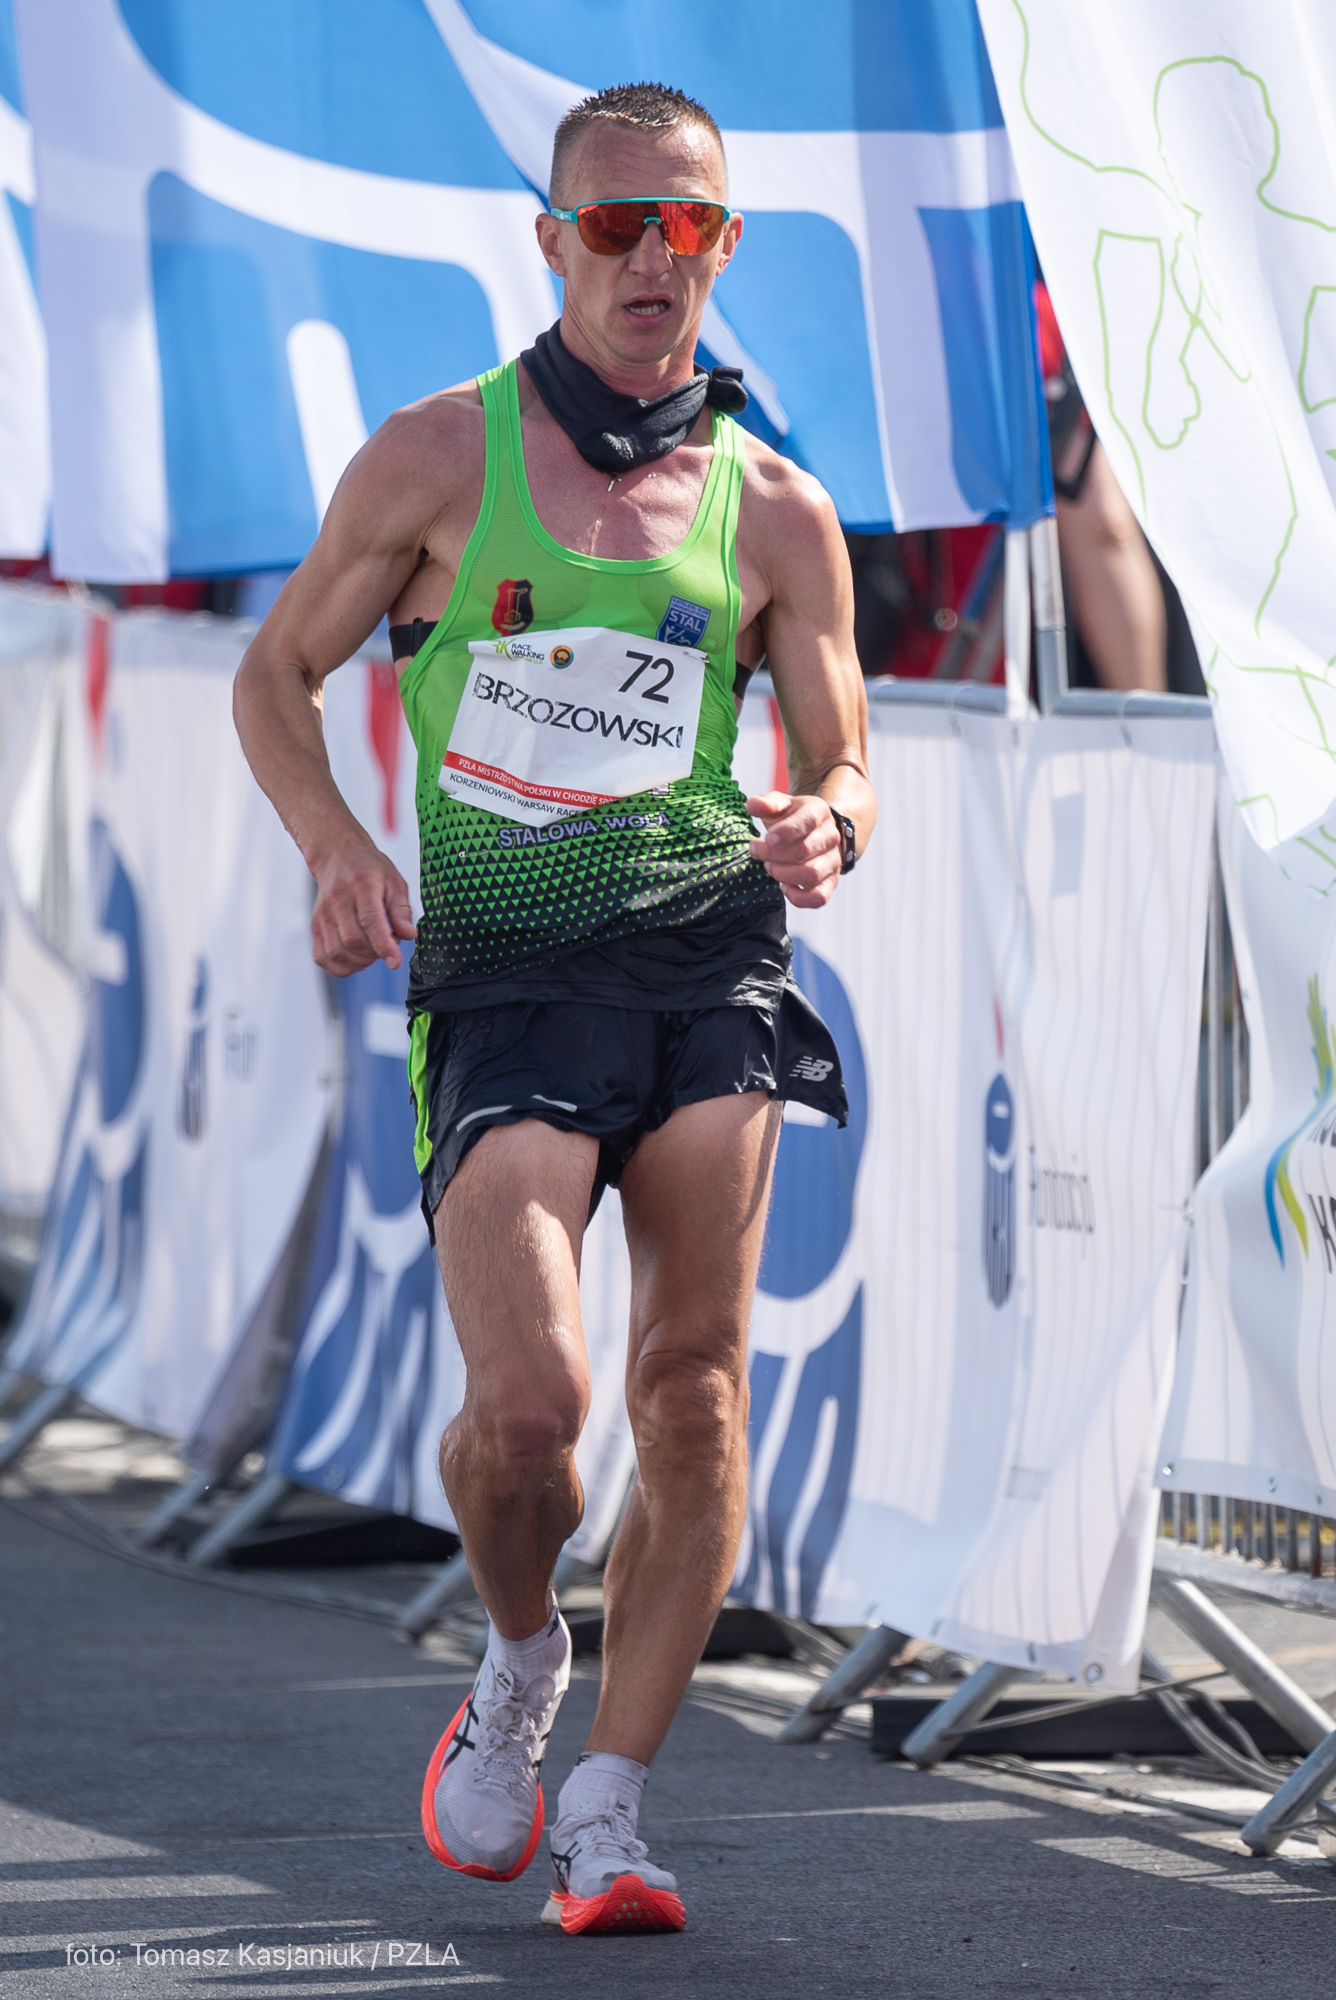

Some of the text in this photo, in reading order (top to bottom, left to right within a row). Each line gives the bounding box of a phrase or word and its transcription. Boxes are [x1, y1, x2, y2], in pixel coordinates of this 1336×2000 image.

[668, 609, 702, 632] STAL
[511, 643, 532, 651] RACE
[511, 648, 545, 661] WALKING
[617, 650, 675, 704] 72
[472, 672, 684, 748] BRZOZOWSKI
[449, 772, 516, 803] KORZENIOWSKI
[516, 797, 556, 814] WARSAW
[458, 758, 476, 772] PZLA
[476, 765, 524, 791] MISTRZOSTWA
[523, 785, 551, 797] POLSKI
[552, 788, 562, 799] W
[562, 791, 598, 804] CHODZIE
[499, 812, 671, 847] STALOWA WOLA
